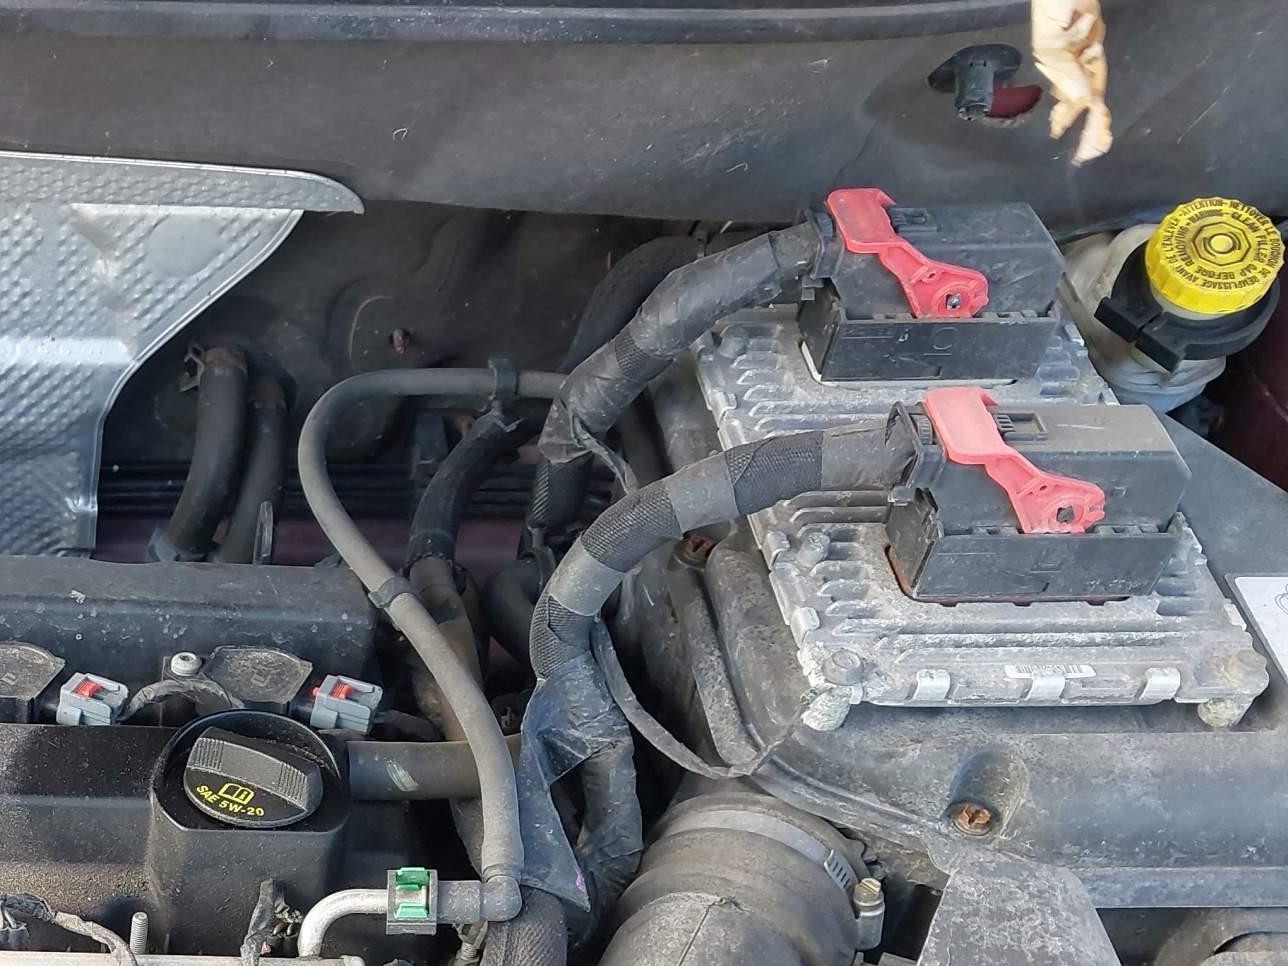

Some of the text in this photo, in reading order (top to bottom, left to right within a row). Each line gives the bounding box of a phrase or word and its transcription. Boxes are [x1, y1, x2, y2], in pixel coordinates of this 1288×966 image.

[1195, 265, 1236, 280] BEFORE
[196, 785, 265, 816] SAE 5W-20
